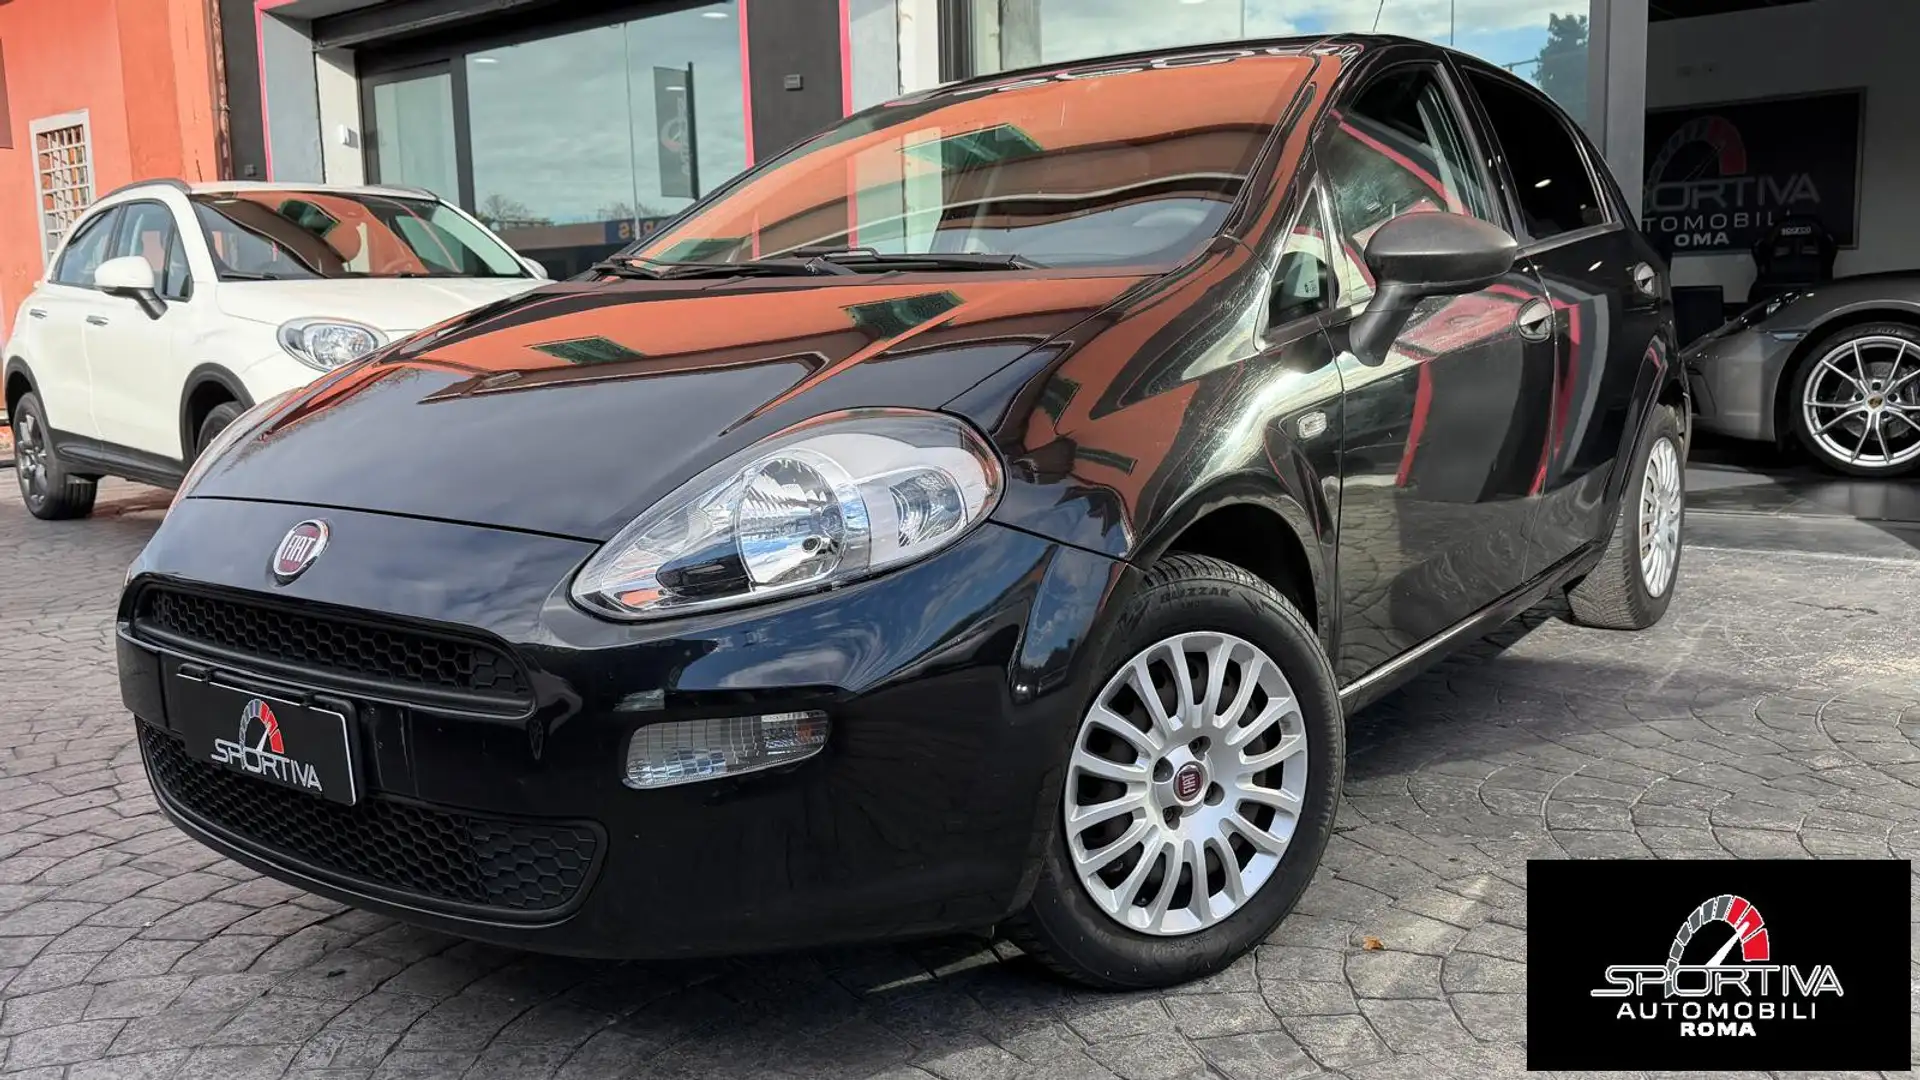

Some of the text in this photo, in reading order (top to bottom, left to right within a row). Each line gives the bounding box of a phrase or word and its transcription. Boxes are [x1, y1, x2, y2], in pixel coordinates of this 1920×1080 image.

[1651, 172, 1821, 213] ORTIVA
[1643, 210, 1791, 233] TOMOBIL
[1673, 231, 1730, 247] OMA
[281, 534, 317, 563] FIAT
[211, 738, 323, 792] SPORTIVA
[1182, 773, 1196, 795] FIAT
